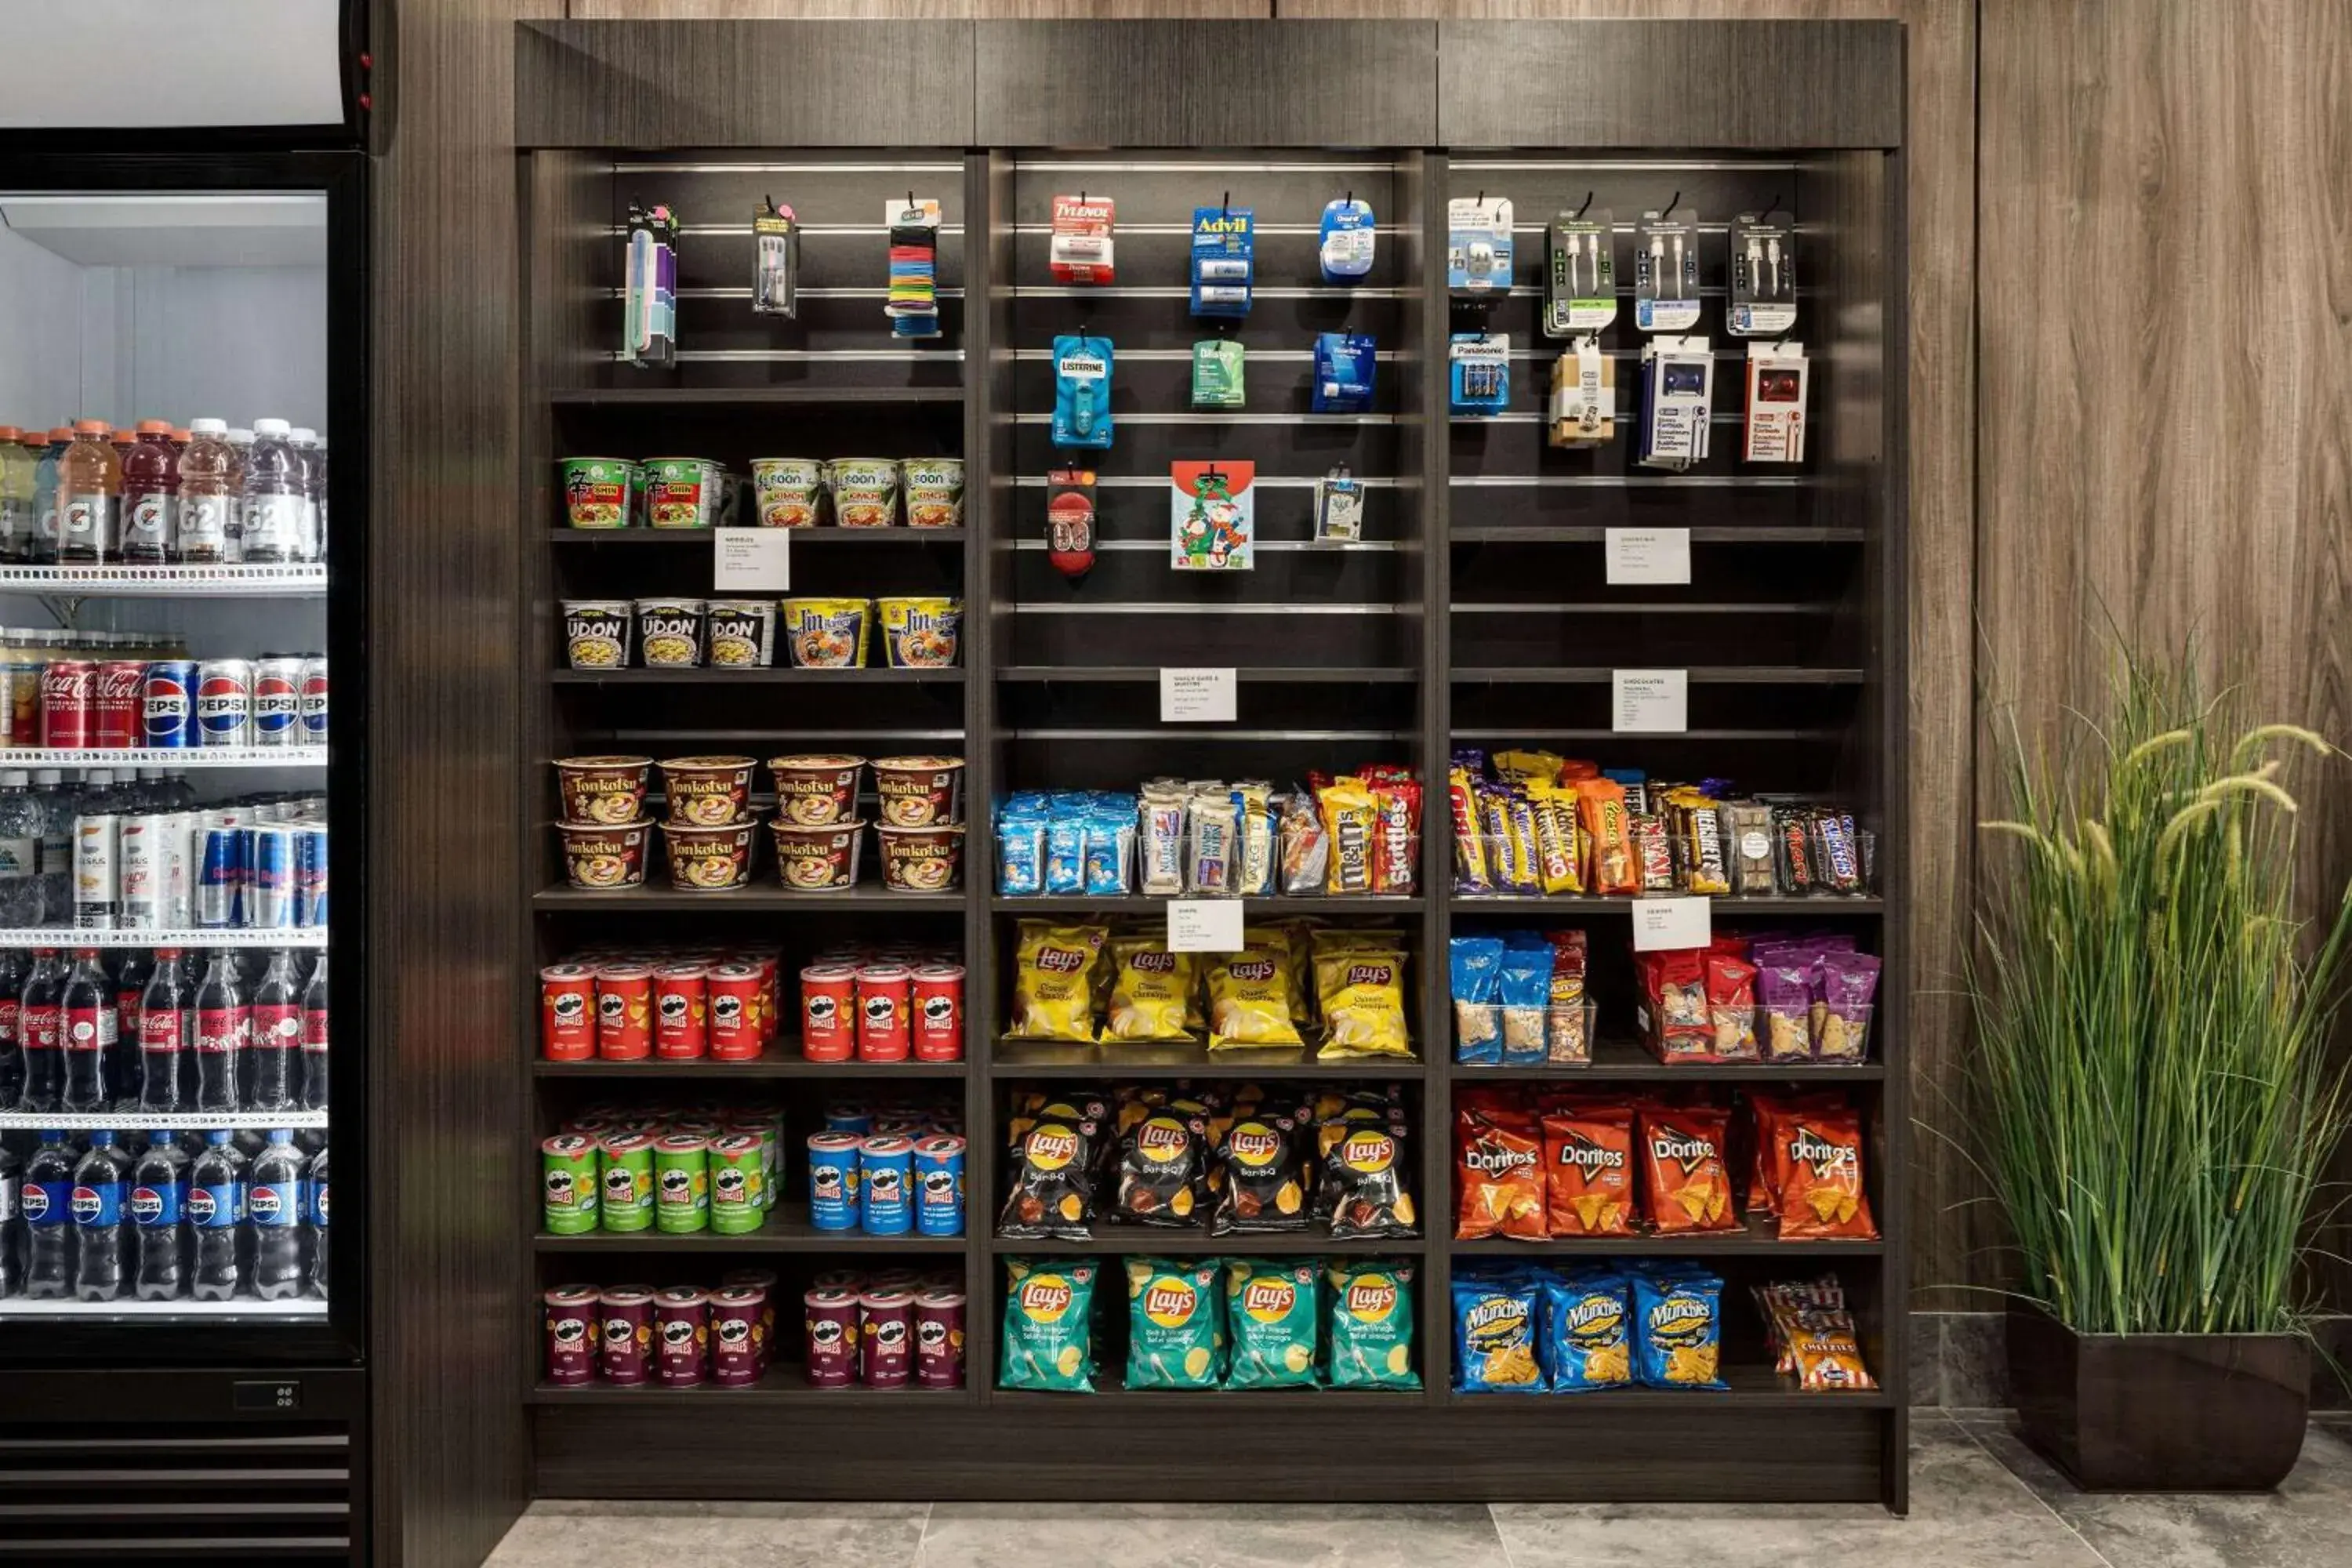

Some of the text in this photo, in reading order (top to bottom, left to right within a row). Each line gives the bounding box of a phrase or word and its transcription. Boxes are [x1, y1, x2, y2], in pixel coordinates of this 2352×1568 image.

[1057, 204, 1109, 217] TYLENOL
[1197, 218, 1247, 232] Advil
[1062, 361, 1104, 372] LISTERINE
[593, 485, 618, 495] SHIN
[667, 485, 691, 495] SHIN
[567, 621, 622, 637] UDON
[641, 618, 696, 636] UDON
[148, 700, 187, 712] EPSI
[199, 699, 248, 711] PEPSI
[258, 699, 297, 711] EPSI
[573, 778, 637, 793] Tonkotsu
[672, 778, 731, 794] Tonkotsu
[672, 840, 732, 855] Tonkotsu
[1697, 808, 1723, 871] HERSHEY'S
[888, 841, 949, 857] Tonkotsu
[1039, 947, 1084, 971] Lay's
[1133, 952, 1174, 972] Lay's
[1232, 959, 1275, 980] Lay's
[1348, 965, 1389, 984] Lay's
[1029, 1134, 1077, 1160] Lay's
[1141, 1126, 1189, 1153] Lay's
[1232, 1131, 1279, 1158] Lay's
[1346, 1140, 1392, 1163] Lay's
[1562, 1145, 1624, 1166] Doritos
[1655, 1140, 1715, 1158] Dorito
[1791, 1142, 1857, 1161] Doritos
[1467, 1149, 1537, 1169] Doritos
[871, 1189, 900, 1203] PRINGLES
[924, 1190, 953, 1203] PRINGLES
[72, 1200, 100, 1210] PEPSI
[132, 1199, 161, 1210] PEPSI
[251, 1199, 278, 1210] PEPSI
[1024, 1284, 1069, 1311] Lay's
[1148, 1289, 1194, 1316] Lay's
[1248, 1285, 1293, 1312] Lay's
[1351, 1284, 1395, 1311] Lay's
[1467, 1299, 1528, 1330] Munchies
[1568, 1301, 1623, 1330] Munchies
[1652, 1301, 1710, 1330] Munchies
[554, 1340, 584, 1353] PRINGLES
[663, 1341, 692, 1354] PRINGLES
[719, 1340, 747, 1353] PRINGLES
[813, 1341, 841, 1355] PRINGLES
[877, 1341, 906, 1356] PRINGLES
